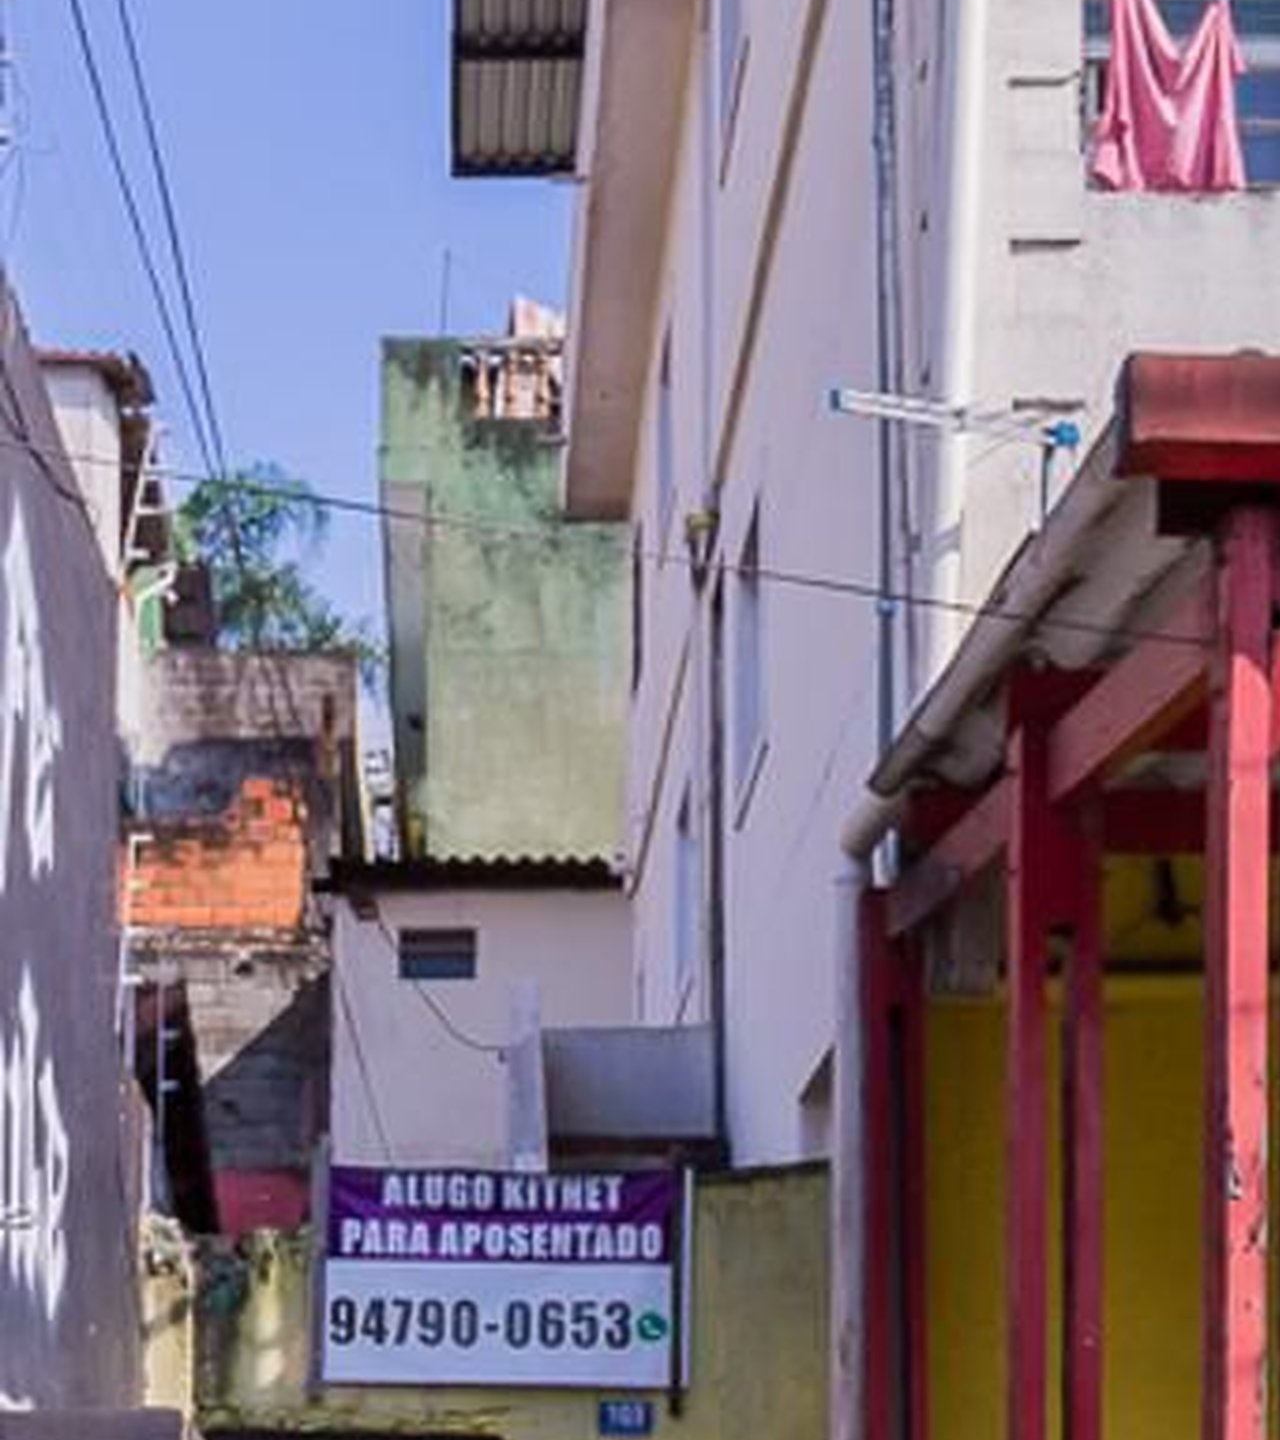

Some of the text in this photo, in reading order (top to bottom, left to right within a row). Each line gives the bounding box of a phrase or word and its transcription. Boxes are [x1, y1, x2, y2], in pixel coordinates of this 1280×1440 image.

[383, 1174, 624, 1212] ALUGO KITNET
[340, 1218, 664, 1259] PARA APOSENTADO
[329, 1296, 632, 1349] 94790-0653
